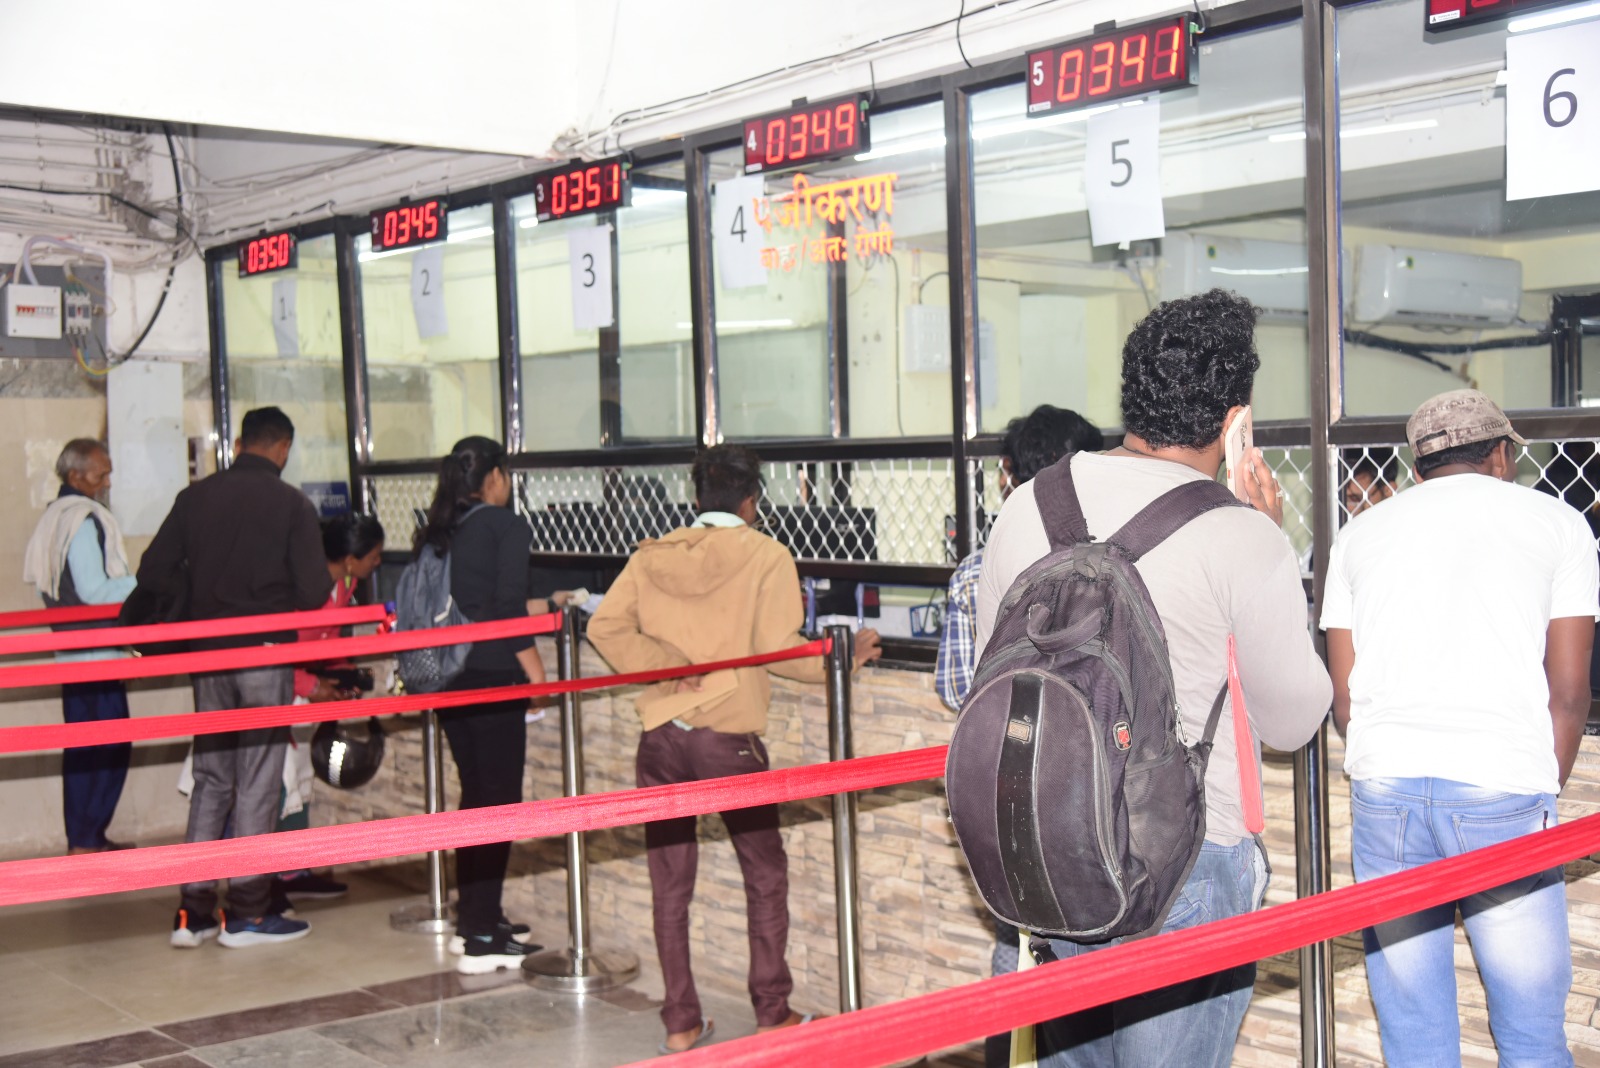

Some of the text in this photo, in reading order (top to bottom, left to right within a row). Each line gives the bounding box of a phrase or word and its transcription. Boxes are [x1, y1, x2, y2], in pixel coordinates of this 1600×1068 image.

[1032, 26, 1180, 103] 5 0341
[1542, 67, 1578, 128] 6
[746, 102, 855, 165] 4 0349
[1110, 138, 1133, 187] 5
[536, 163, 620, 215] 3 0351
[372, 201, 438, 247] 2 0345
[730, 205, 747, 243] 4
[247, 233, 289, 273] 0350
[582, 253, 596, 288] 3
[420, 268, 431, 297] 2
[279, 297, 288, 321] 1
